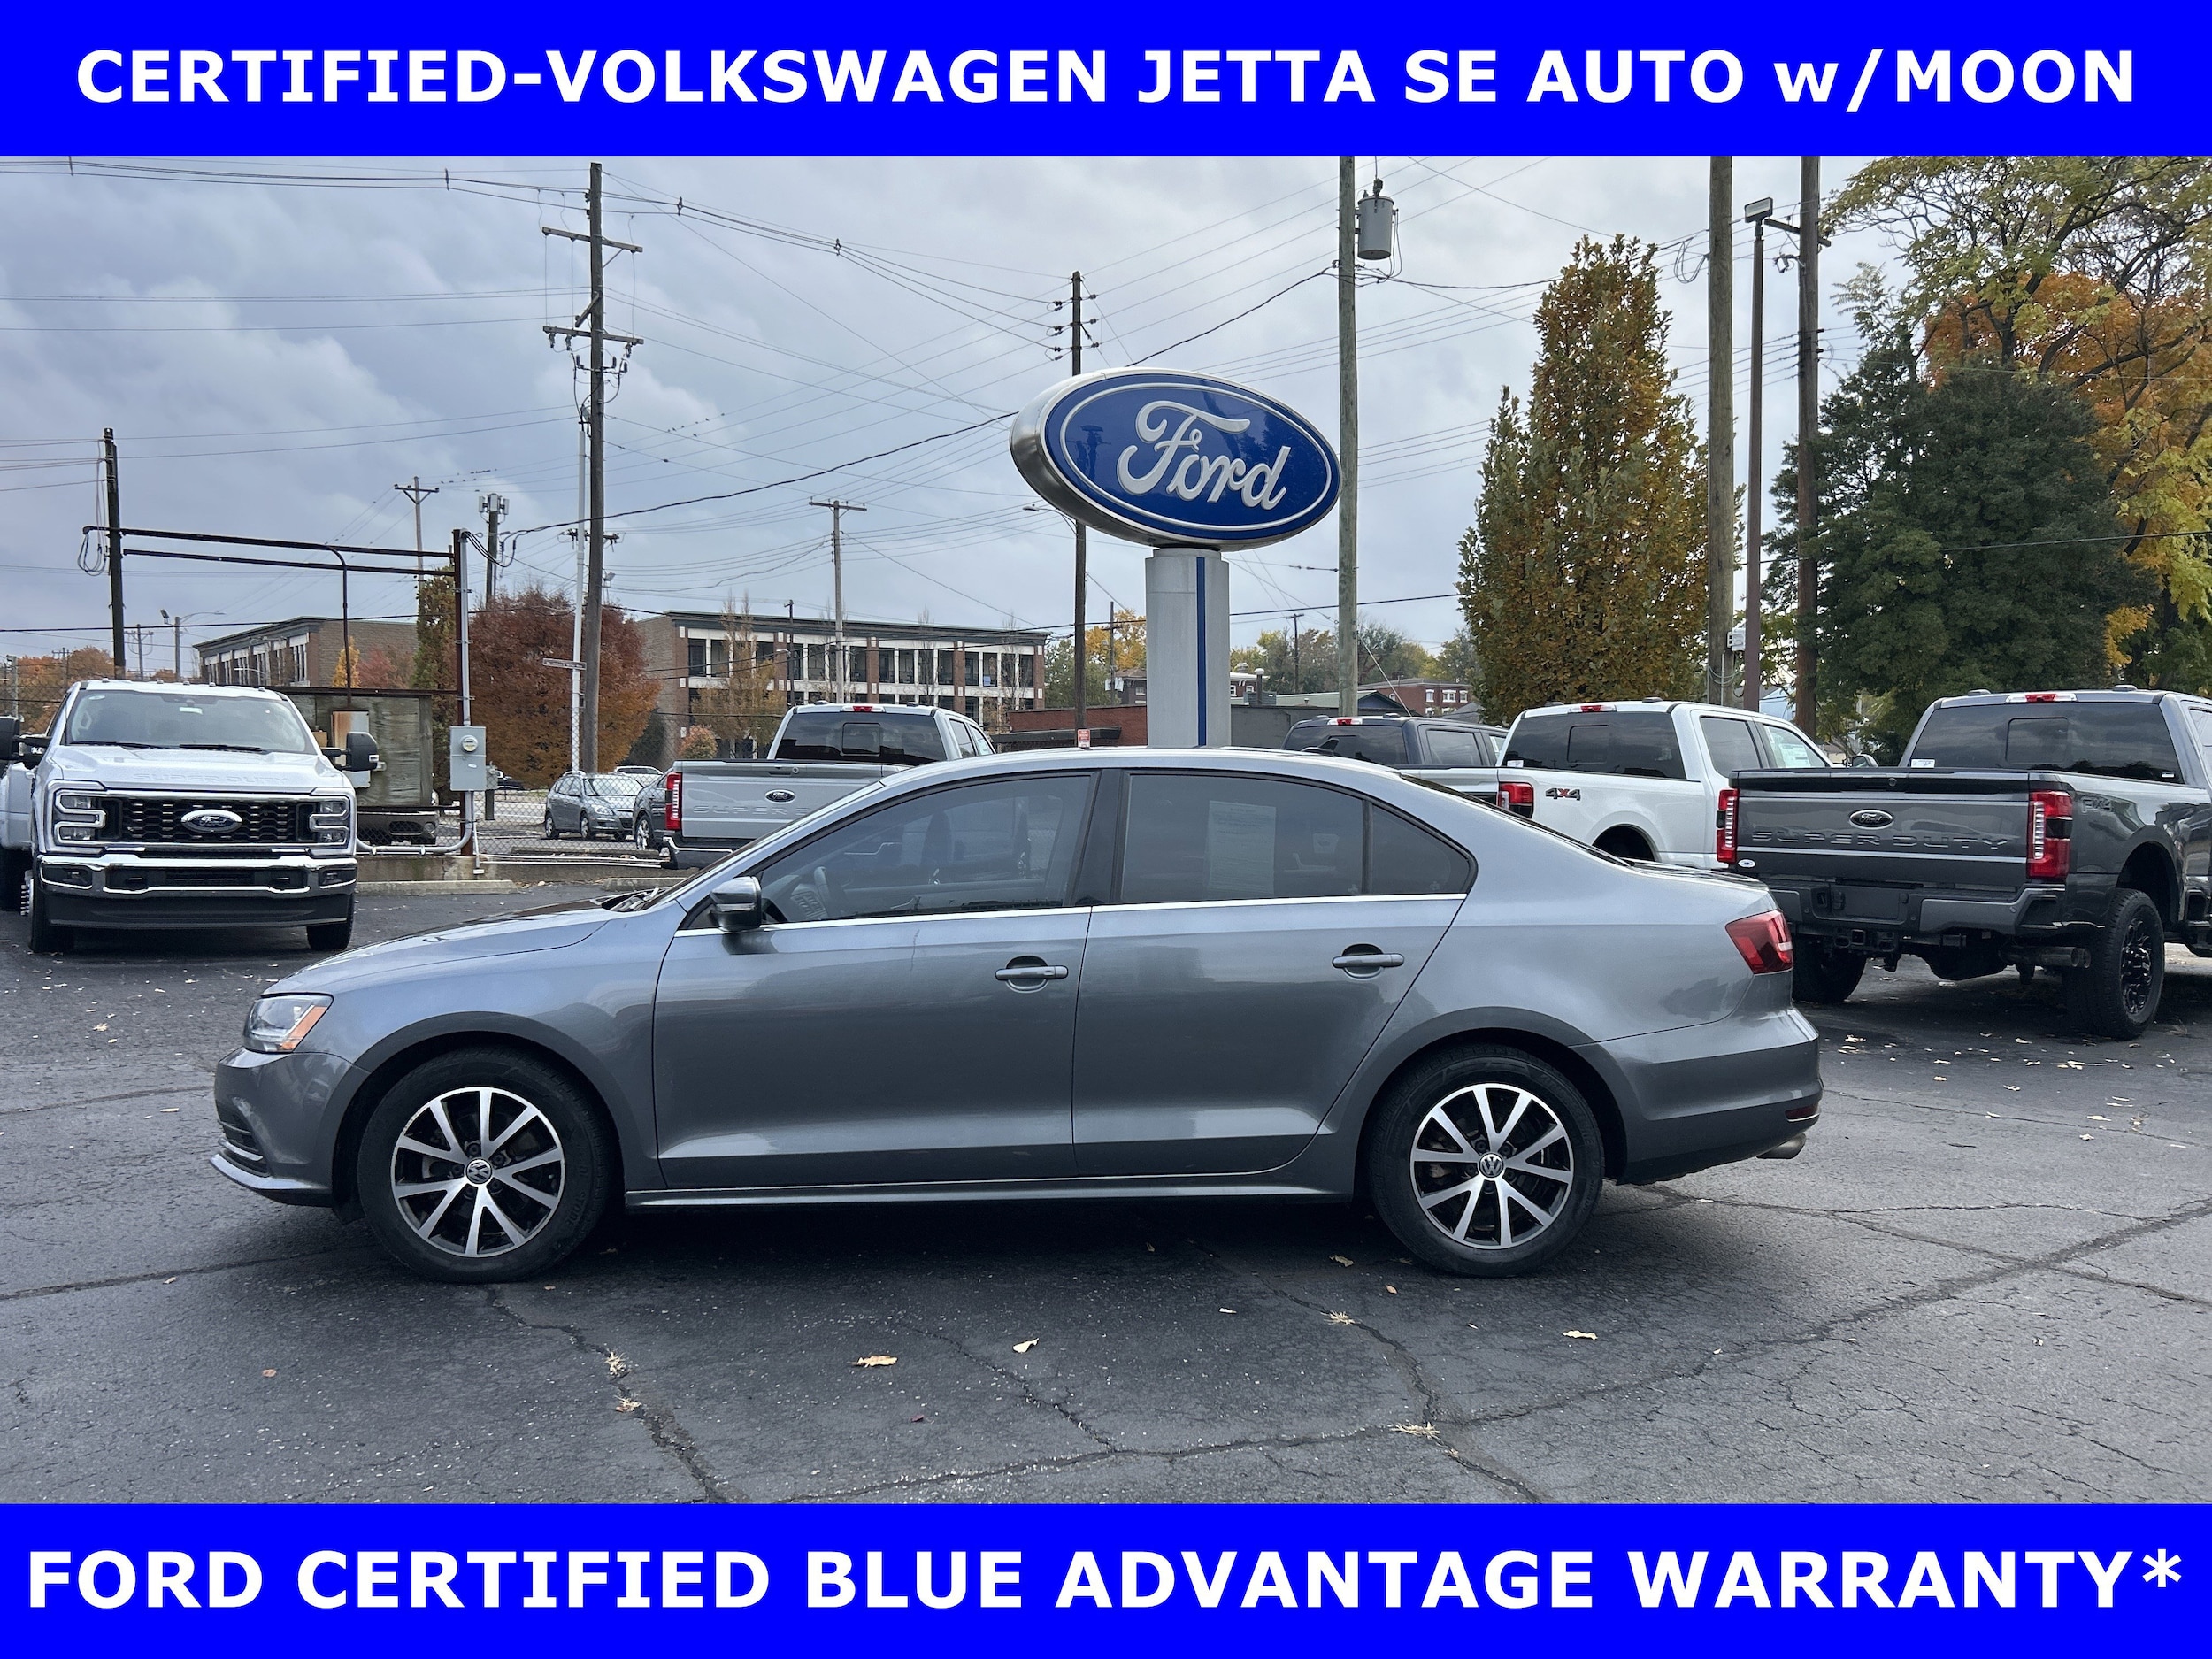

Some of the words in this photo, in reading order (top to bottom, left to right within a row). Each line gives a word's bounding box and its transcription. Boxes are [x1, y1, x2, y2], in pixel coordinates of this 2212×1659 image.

[1116, 400, 1293, 511] Ford
[692, 805, 788, 815] SUPER
[2080, 796, 2115, 814] FX4
[1751, 830, 1881, 847] SUPER
[1893, 834, 2008, 850] DUTY
